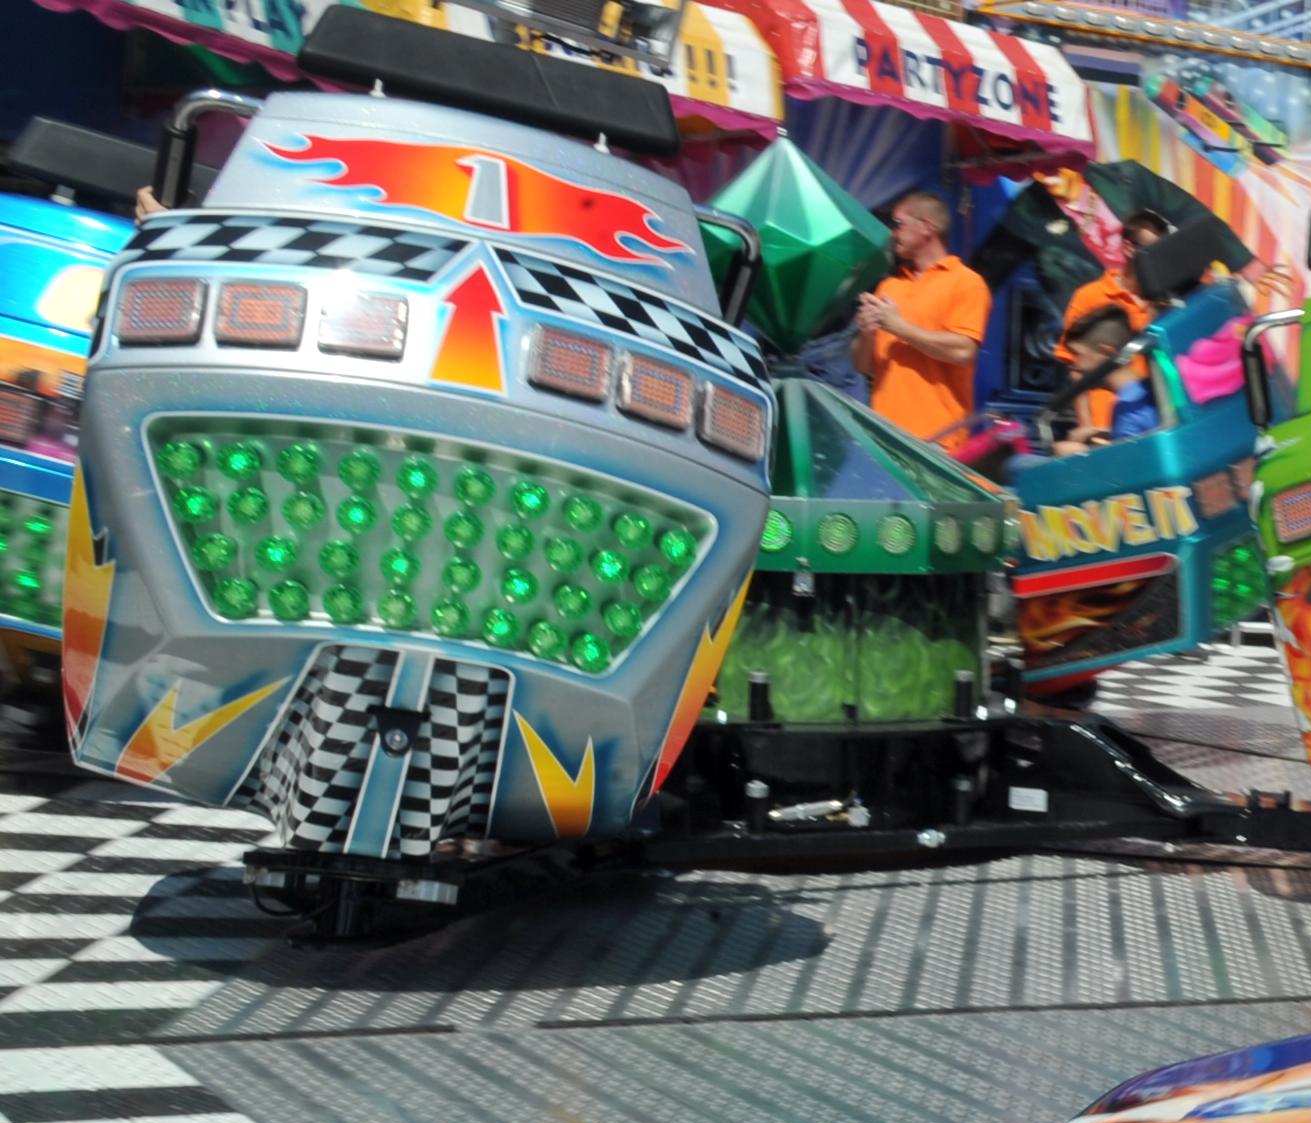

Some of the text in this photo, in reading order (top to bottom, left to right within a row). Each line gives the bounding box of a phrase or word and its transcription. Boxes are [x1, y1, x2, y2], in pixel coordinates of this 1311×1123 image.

[853, 36, 1062, 124] PARTYZONE
[455, 155, 511, 230] 1
[1018, 486, 1199, 562] MOVE IT
